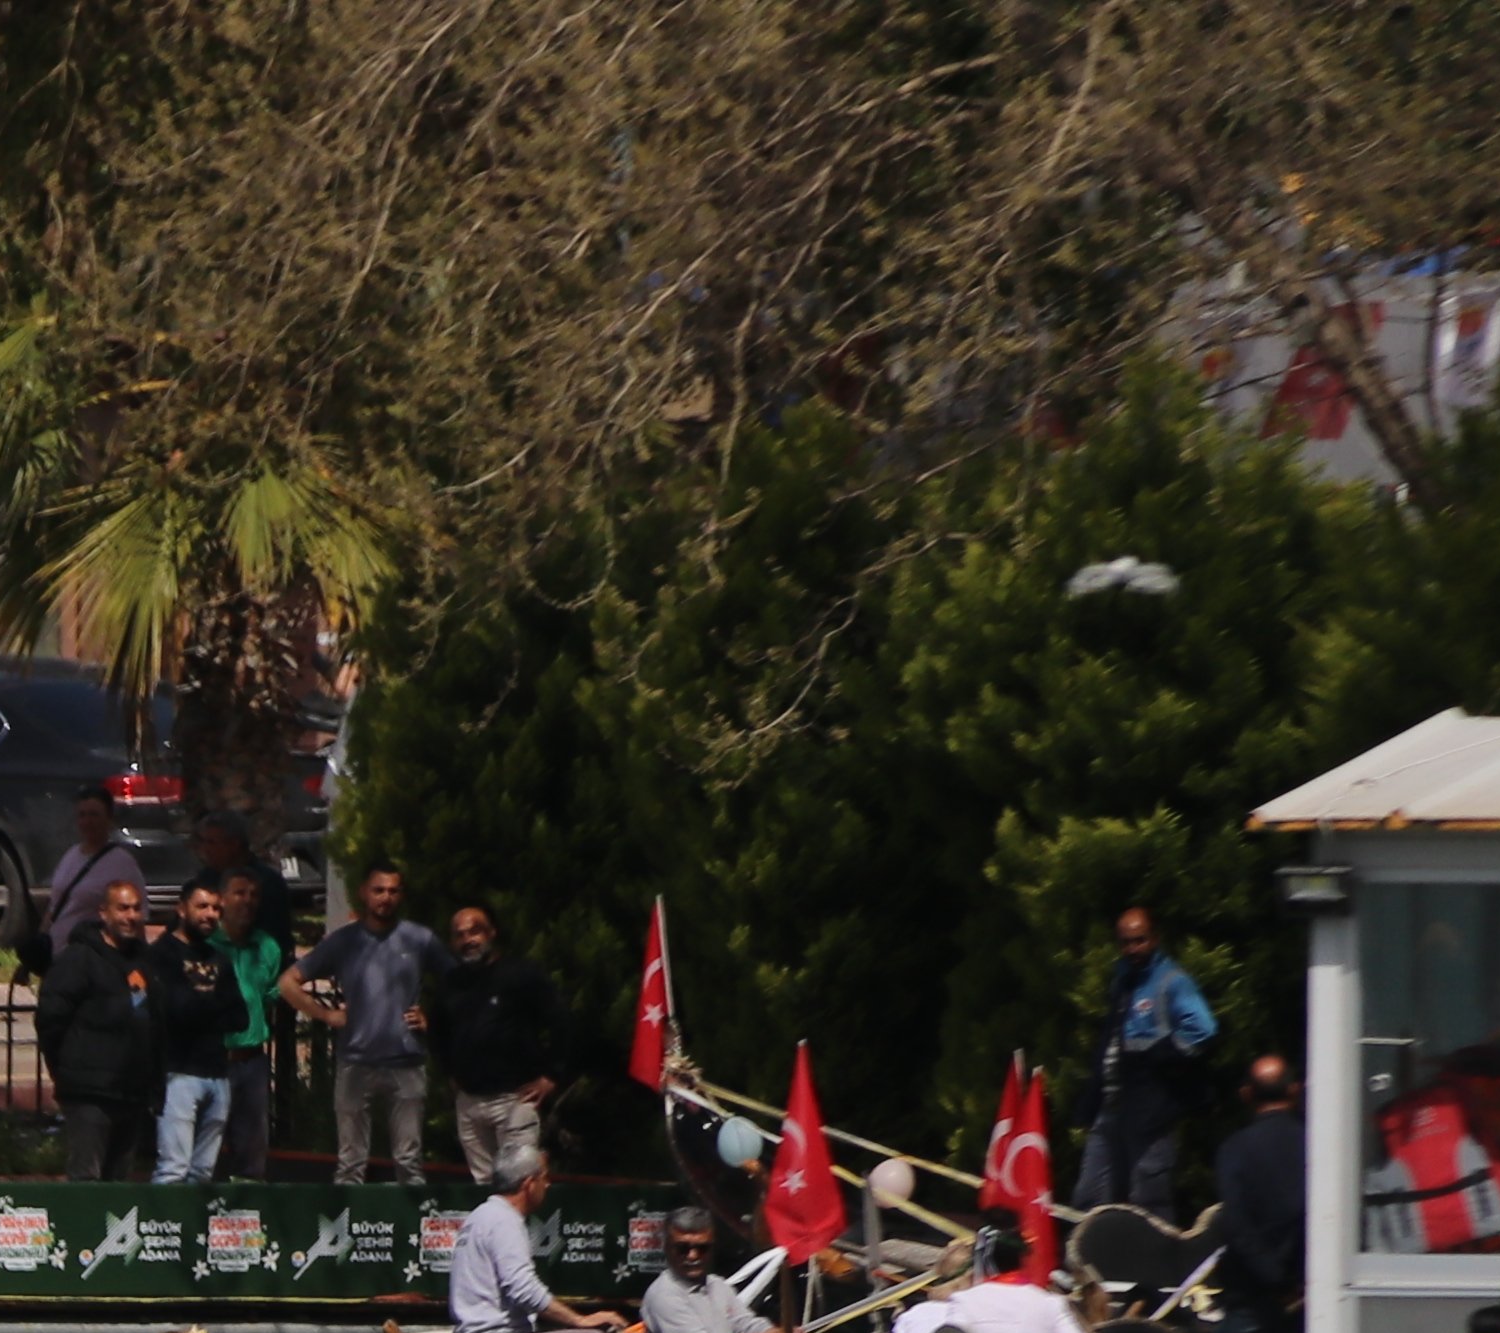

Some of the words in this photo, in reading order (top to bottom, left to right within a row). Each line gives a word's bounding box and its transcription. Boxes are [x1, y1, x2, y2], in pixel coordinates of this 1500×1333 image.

[138, 1219, 182, 1234] BÜYÜK
[351, 1221, 395, 1235] BÜYÜK
[562, 1221, 606, 1236] BÜYÜK
[144, 1235, 182, 1249] ŞEHİR
[356, 1236, 394, 1250] ŞEHİR
[138, 1249, 182, 1263] ADANA
[350, 1250, 394, 1263] ADANA
[562, 1250, 605, 1264] ADANA
